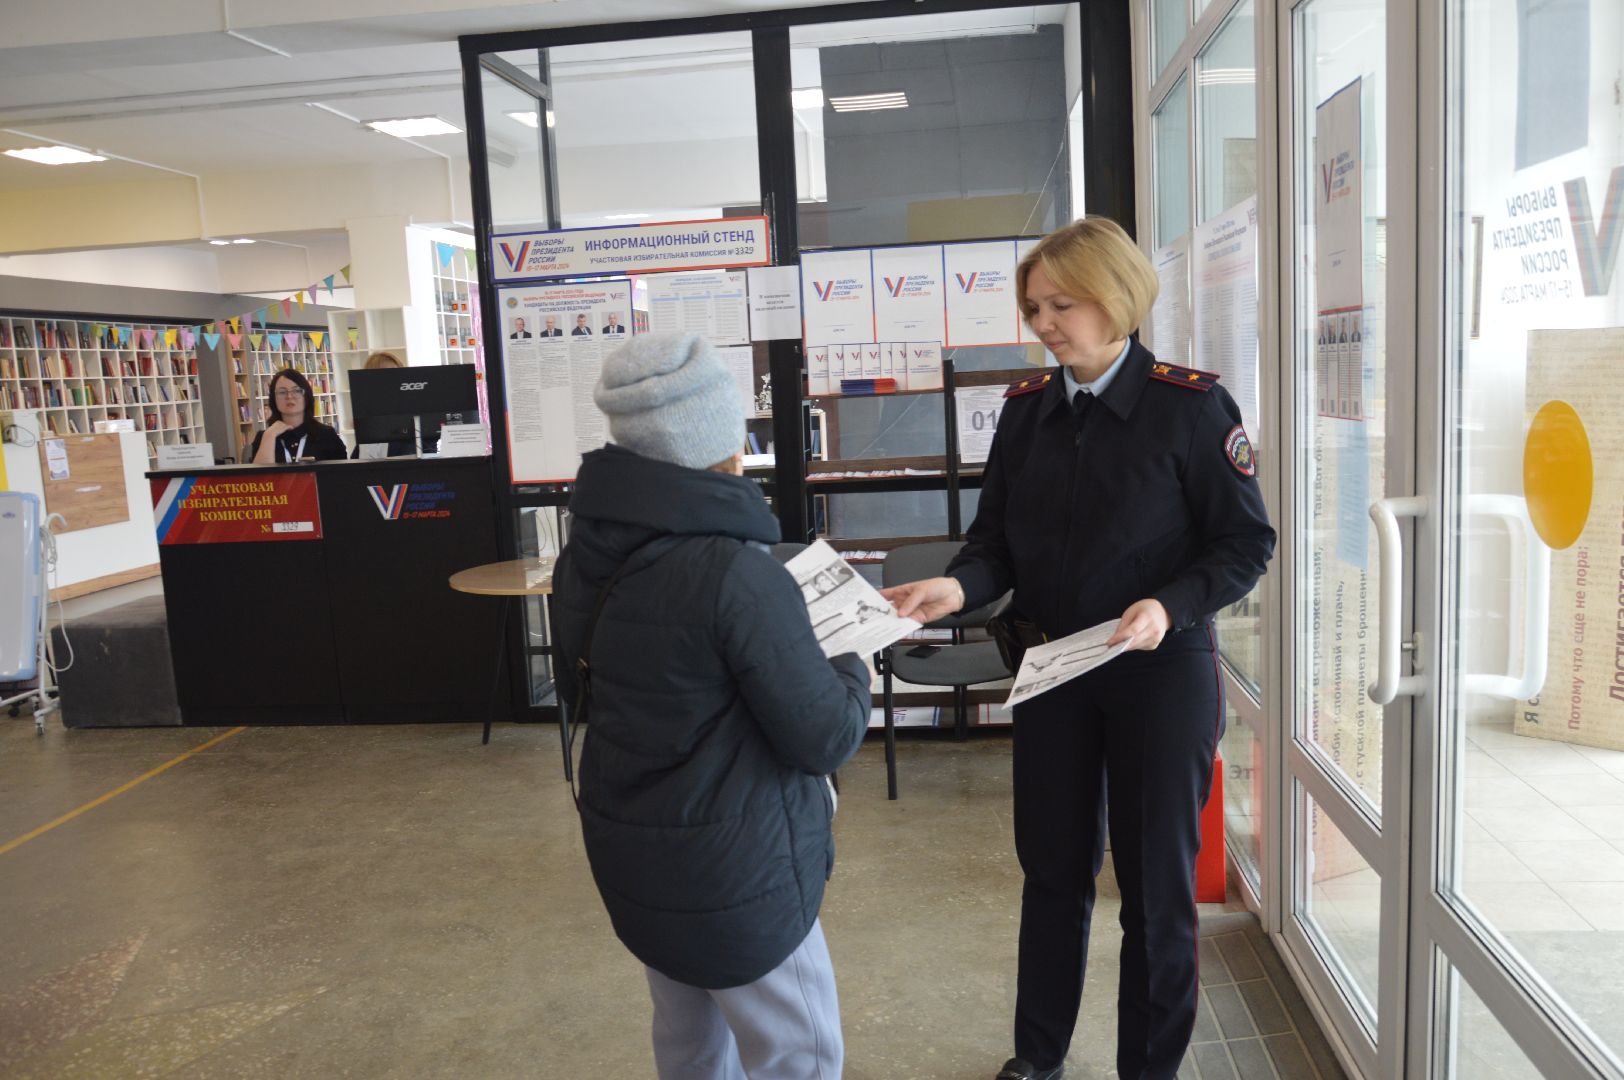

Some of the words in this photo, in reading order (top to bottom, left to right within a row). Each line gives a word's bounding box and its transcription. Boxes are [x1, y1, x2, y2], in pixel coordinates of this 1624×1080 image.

[534, 238, 565, 247] ВЫБОРЫ
[585, 230, 710, 251] ИНФОРМАЦИОННЫЙ
[713, 229, 755, 243] СТЕНД
[531, 246, 575, 256] ПРЕЗИДЕНТА
[590, 255, 632, 264] УЧАСТКОВАЯ
[633, 251, 689, 262] ИЗБИРАТЕЛЬНАЯ
[690, 249, 727, 258] КОМИССИЯ
[735, 246, 754, 255] 3329
[528, 256, 557, 264] РОССИИ
[400, 381, 428, 391] acer
[972, 409, 997, 431] 01
[190, 481, 274, 496] УЧАСТКОВАЯ
[178, 495, 288, 509] ИЗБИРАТЕЛЬНАЯ
[200, 509, 272, 522] КОМИССИЯ
[261, 524, 271, 533] №
[1335, 580, 1345, 628] плачь,
[1356, 568, 1368, 639] брошенн
[1575, 590, 1586, 609] не
[1609, 552, 1624, 702] Достига
[1335, 632, 1342, 641] и
[1573, 648, 1584, 673] что
[1357, 643, 1366, 706] планеты
[1568, 677, 1585, 731] Потому
[1524, 712, 1540, 724] Я
[1355, 711, 1366, 767] тусклой
[1357, 769, 1364, 778] с
